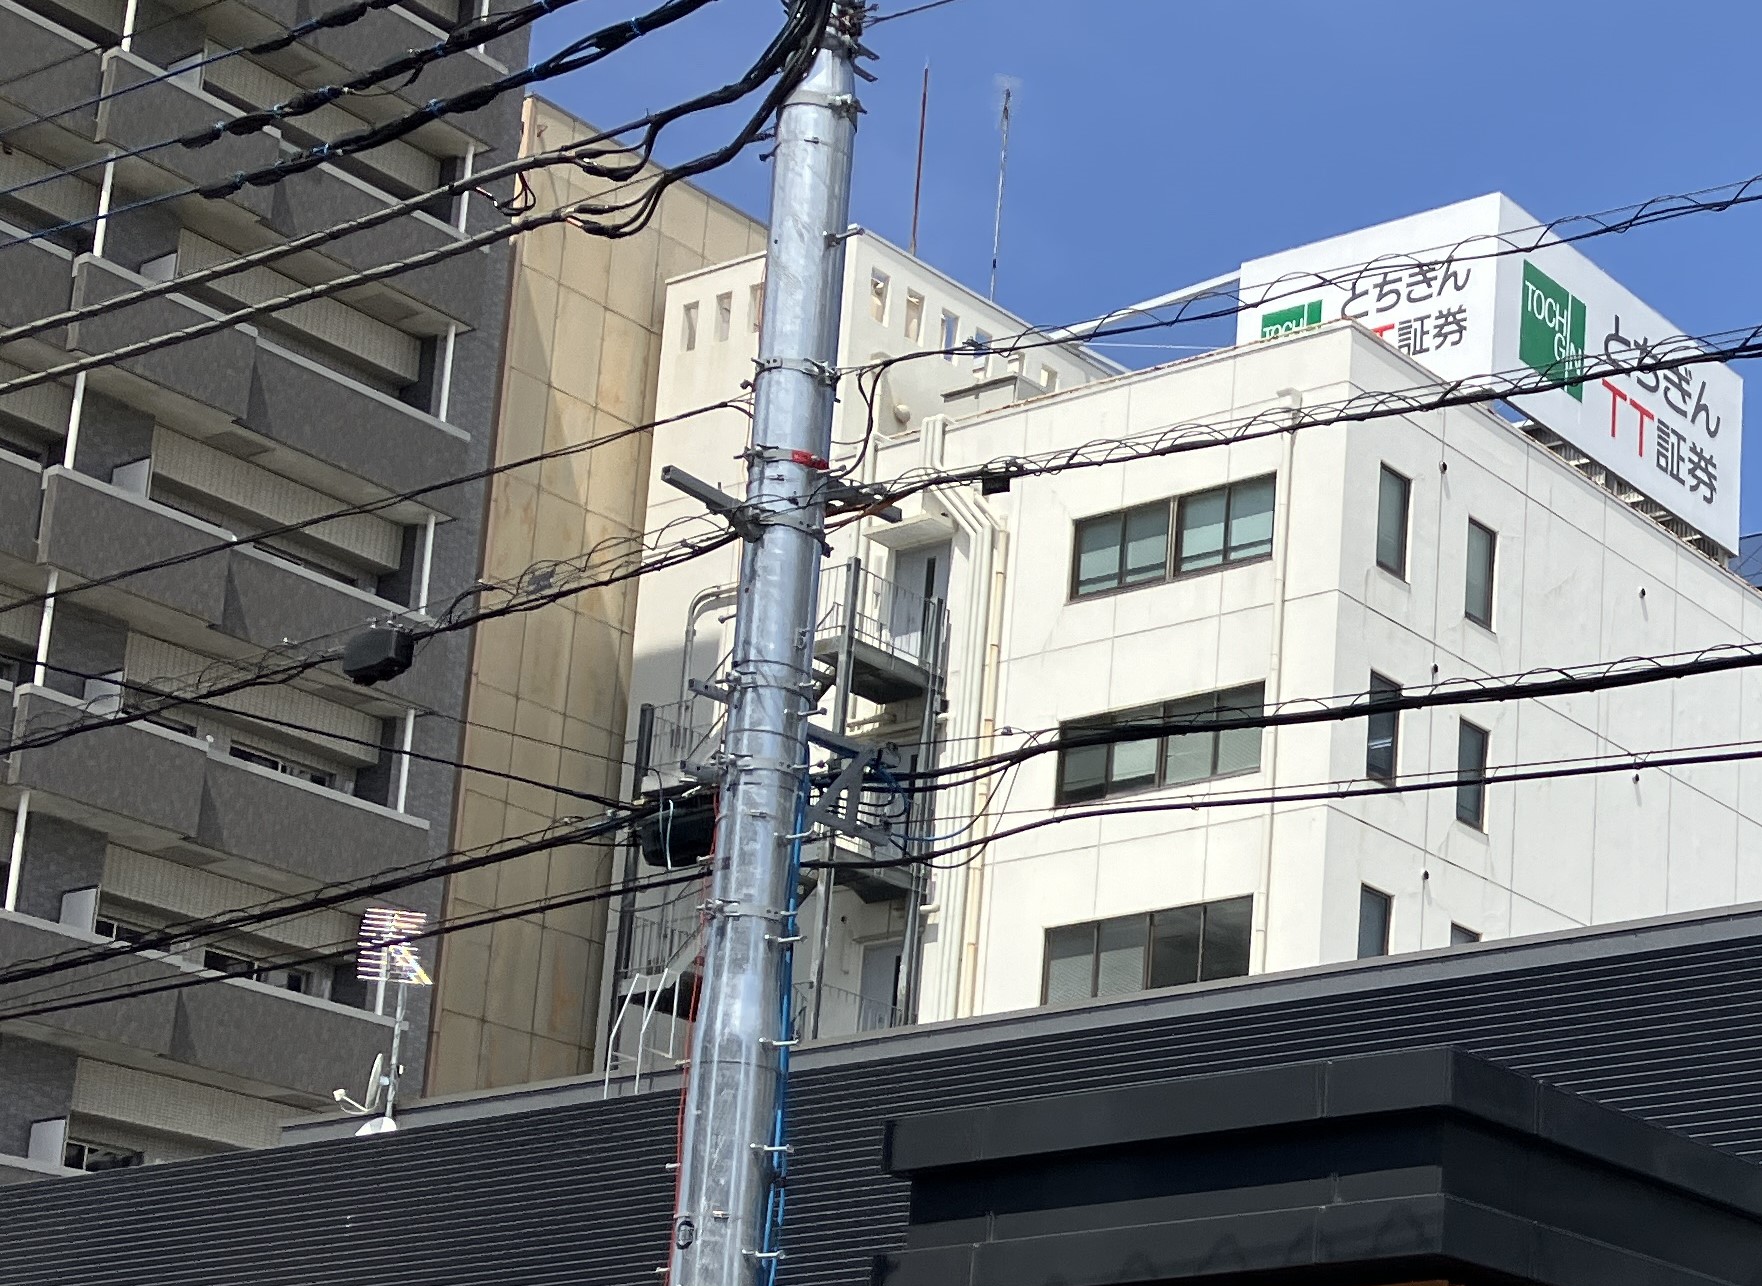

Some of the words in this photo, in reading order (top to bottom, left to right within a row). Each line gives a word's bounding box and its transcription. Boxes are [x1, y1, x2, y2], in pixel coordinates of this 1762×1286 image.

[1341, 254, 1471, 319] とちぎん
[1525, 280, 1571, 337] TOCHI
[1604, 315, 1720, 438] とちぎん
